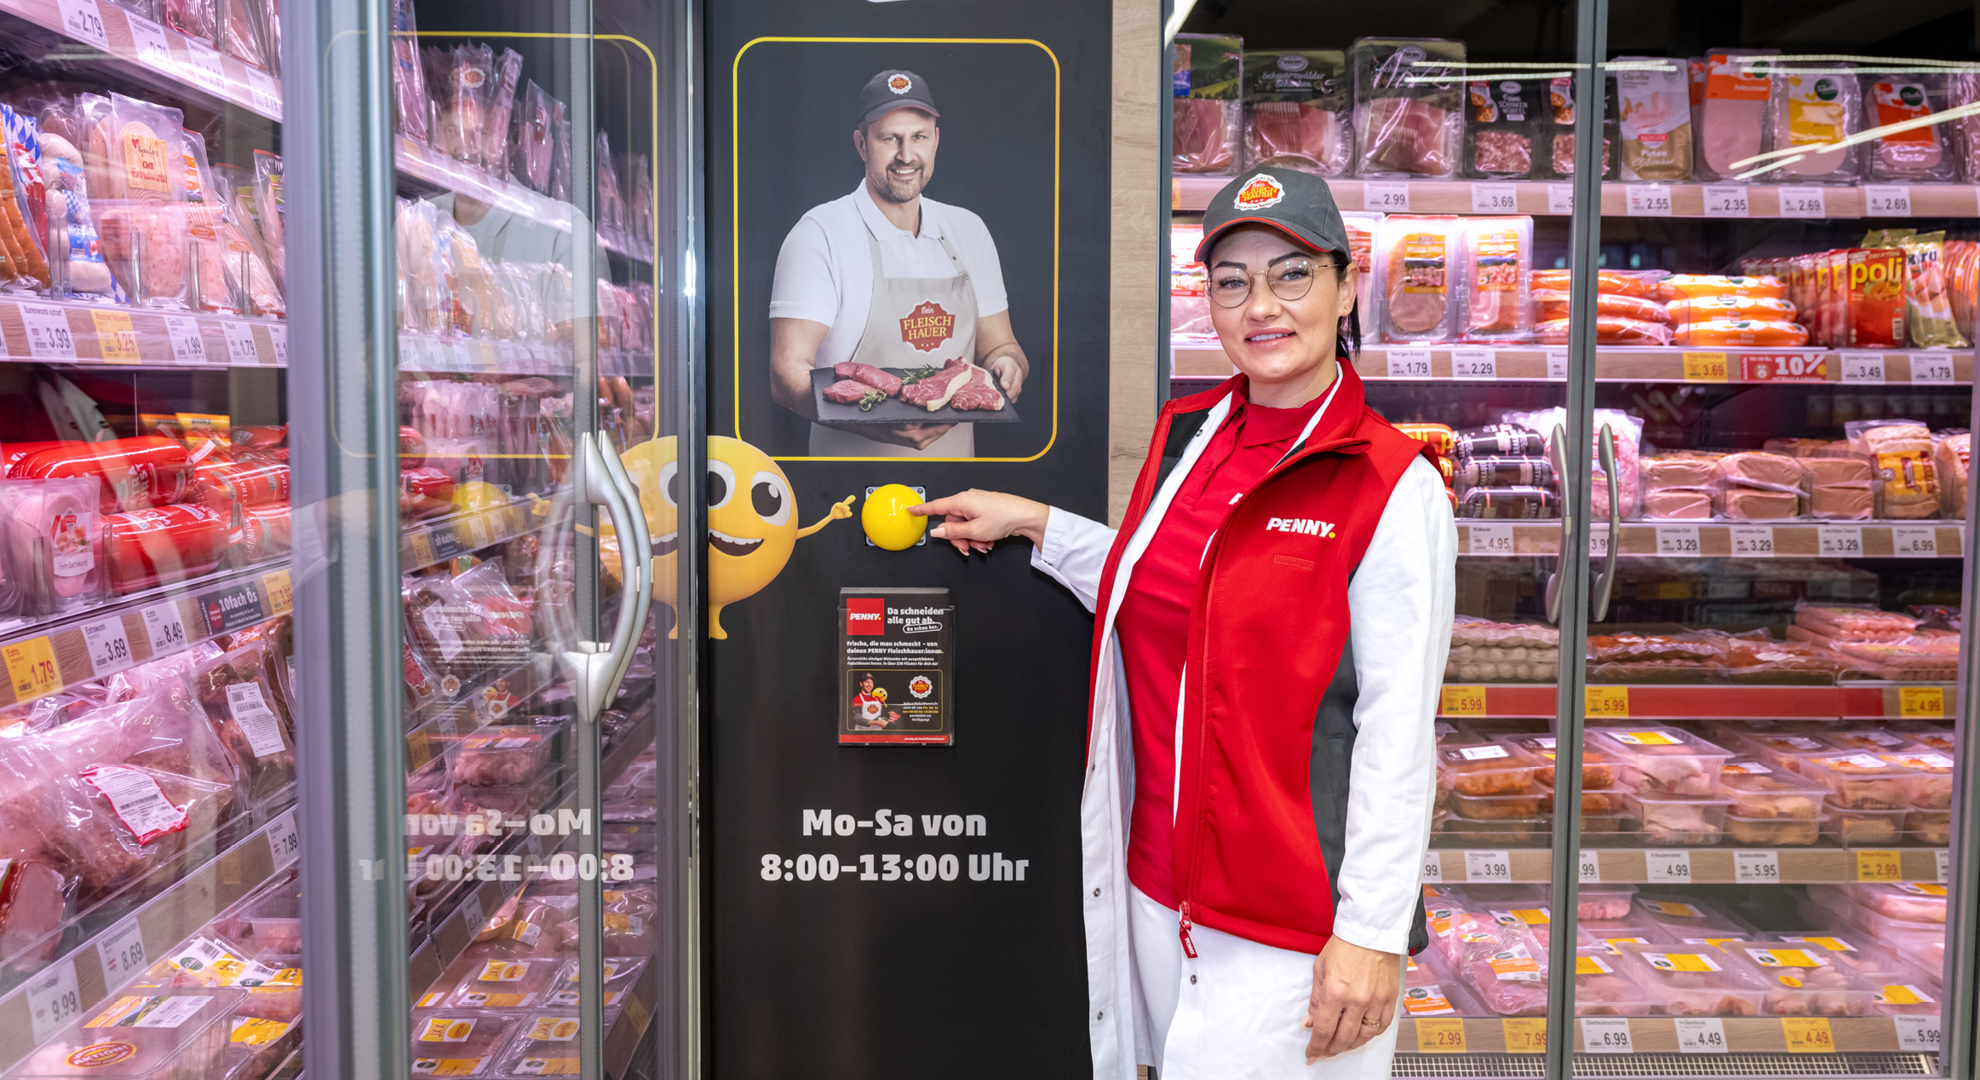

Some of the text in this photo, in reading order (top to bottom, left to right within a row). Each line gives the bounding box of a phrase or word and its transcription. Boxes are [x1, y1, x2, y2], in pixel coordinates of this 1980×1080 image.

[79, 10, 103, 38] 2.79
[1262, 71, 1326, 80] Schwarzwälder
[1622, 73, 1650, 81] Quelle
[1641, 150, 1668, 158] Puten
[1241, 186, 1278, 199] FLEISCH
[1243, 192, 1273, 203] HAUER
[1384, 194, 1406, 205] 2.99
[1492, 196, 1514, 208] 3.69
[1647, 198, 1669, 210] 2.55
[1724, 199, 1747, 211] 2.35
[1886, 199, 1907, 210] 2.69
[1799, 200, 1821, 212] 2.69
[1851, 257, 1903, 290] poli
[921, 306, 935, 315] Mein
[903, 316, 953, 331] FLEISCH
[46, 327, 71, 349] 3.99
[908, 327, 948, 340] HAUER
[114, 332, 135, 353] 3.25
[185, 336, 202, 355] 1.99
[240, 340, 256, 357] 1.79
[1407, 363, 1428, 374] 1.79
[1471, 363, 1493, 375] 2.29
[1703, 364, 1725, 376] 3.69
[1775, 353, 1826, 376] 10%
[1860, 366, 1881, 378] 3.49
[1930, 367, 1951, 378] 1.79
[1266, 517, 1337, 540] PENNY.
[1489, 538, 1510, 549] 4.95
[1676, 539, 1697, 551] 3.29
[1751, 540, 1772, 552] 3.29
[1838, 540, 1859, 551] 3.29
[1913, 540, 1934, 552] 6.99
[219, 592, 248, 612] 10fach
[850, 613, 882, 621] PENNY.
[900, 607, 944, 615] schneiden
[905, 618, 921, 626] gut
[922, 617, 936, 625] ab.
[85, 624, 107, 635] Extrawurst
[164, 622, 183, 643] 8.49
[105, 638, 127, 662] 3.69
[31, 660, 55, 686] 1.79
[1461, 699, 1483, 711] 5.99
[1604, 700, 1626, 712] 5.99
[1919, 701, 1941, 713] 4.99
[921, 814, 987, 837] von
[282, 832, 298, 855] 7.99
[968, 852, 1029, 882] Uhr
[1485, 864, 1507, 876] 3.99
[1580, 864, 1595, 876] .99
[1667, 865, 1688, 876] 4.99
[1755, 864, 1776, 877] 5.95
[1876, 864, 1898, 876] 2.99
[121, 941, 142, 972] 8.69
[52, 991, 76, 1022] 9.99
[1438, 1032, 1462, 1046] 2.99
[1525, 1033, 1547, 1046] 7.99
[1604, 1032, 1628, 1046] 6.99
[1698, 1032, 1722, 1046] 4.49
[1806, 1031, 1829, 1045] 4.49
[1918, 1029, 1941, 1043] 5.99
